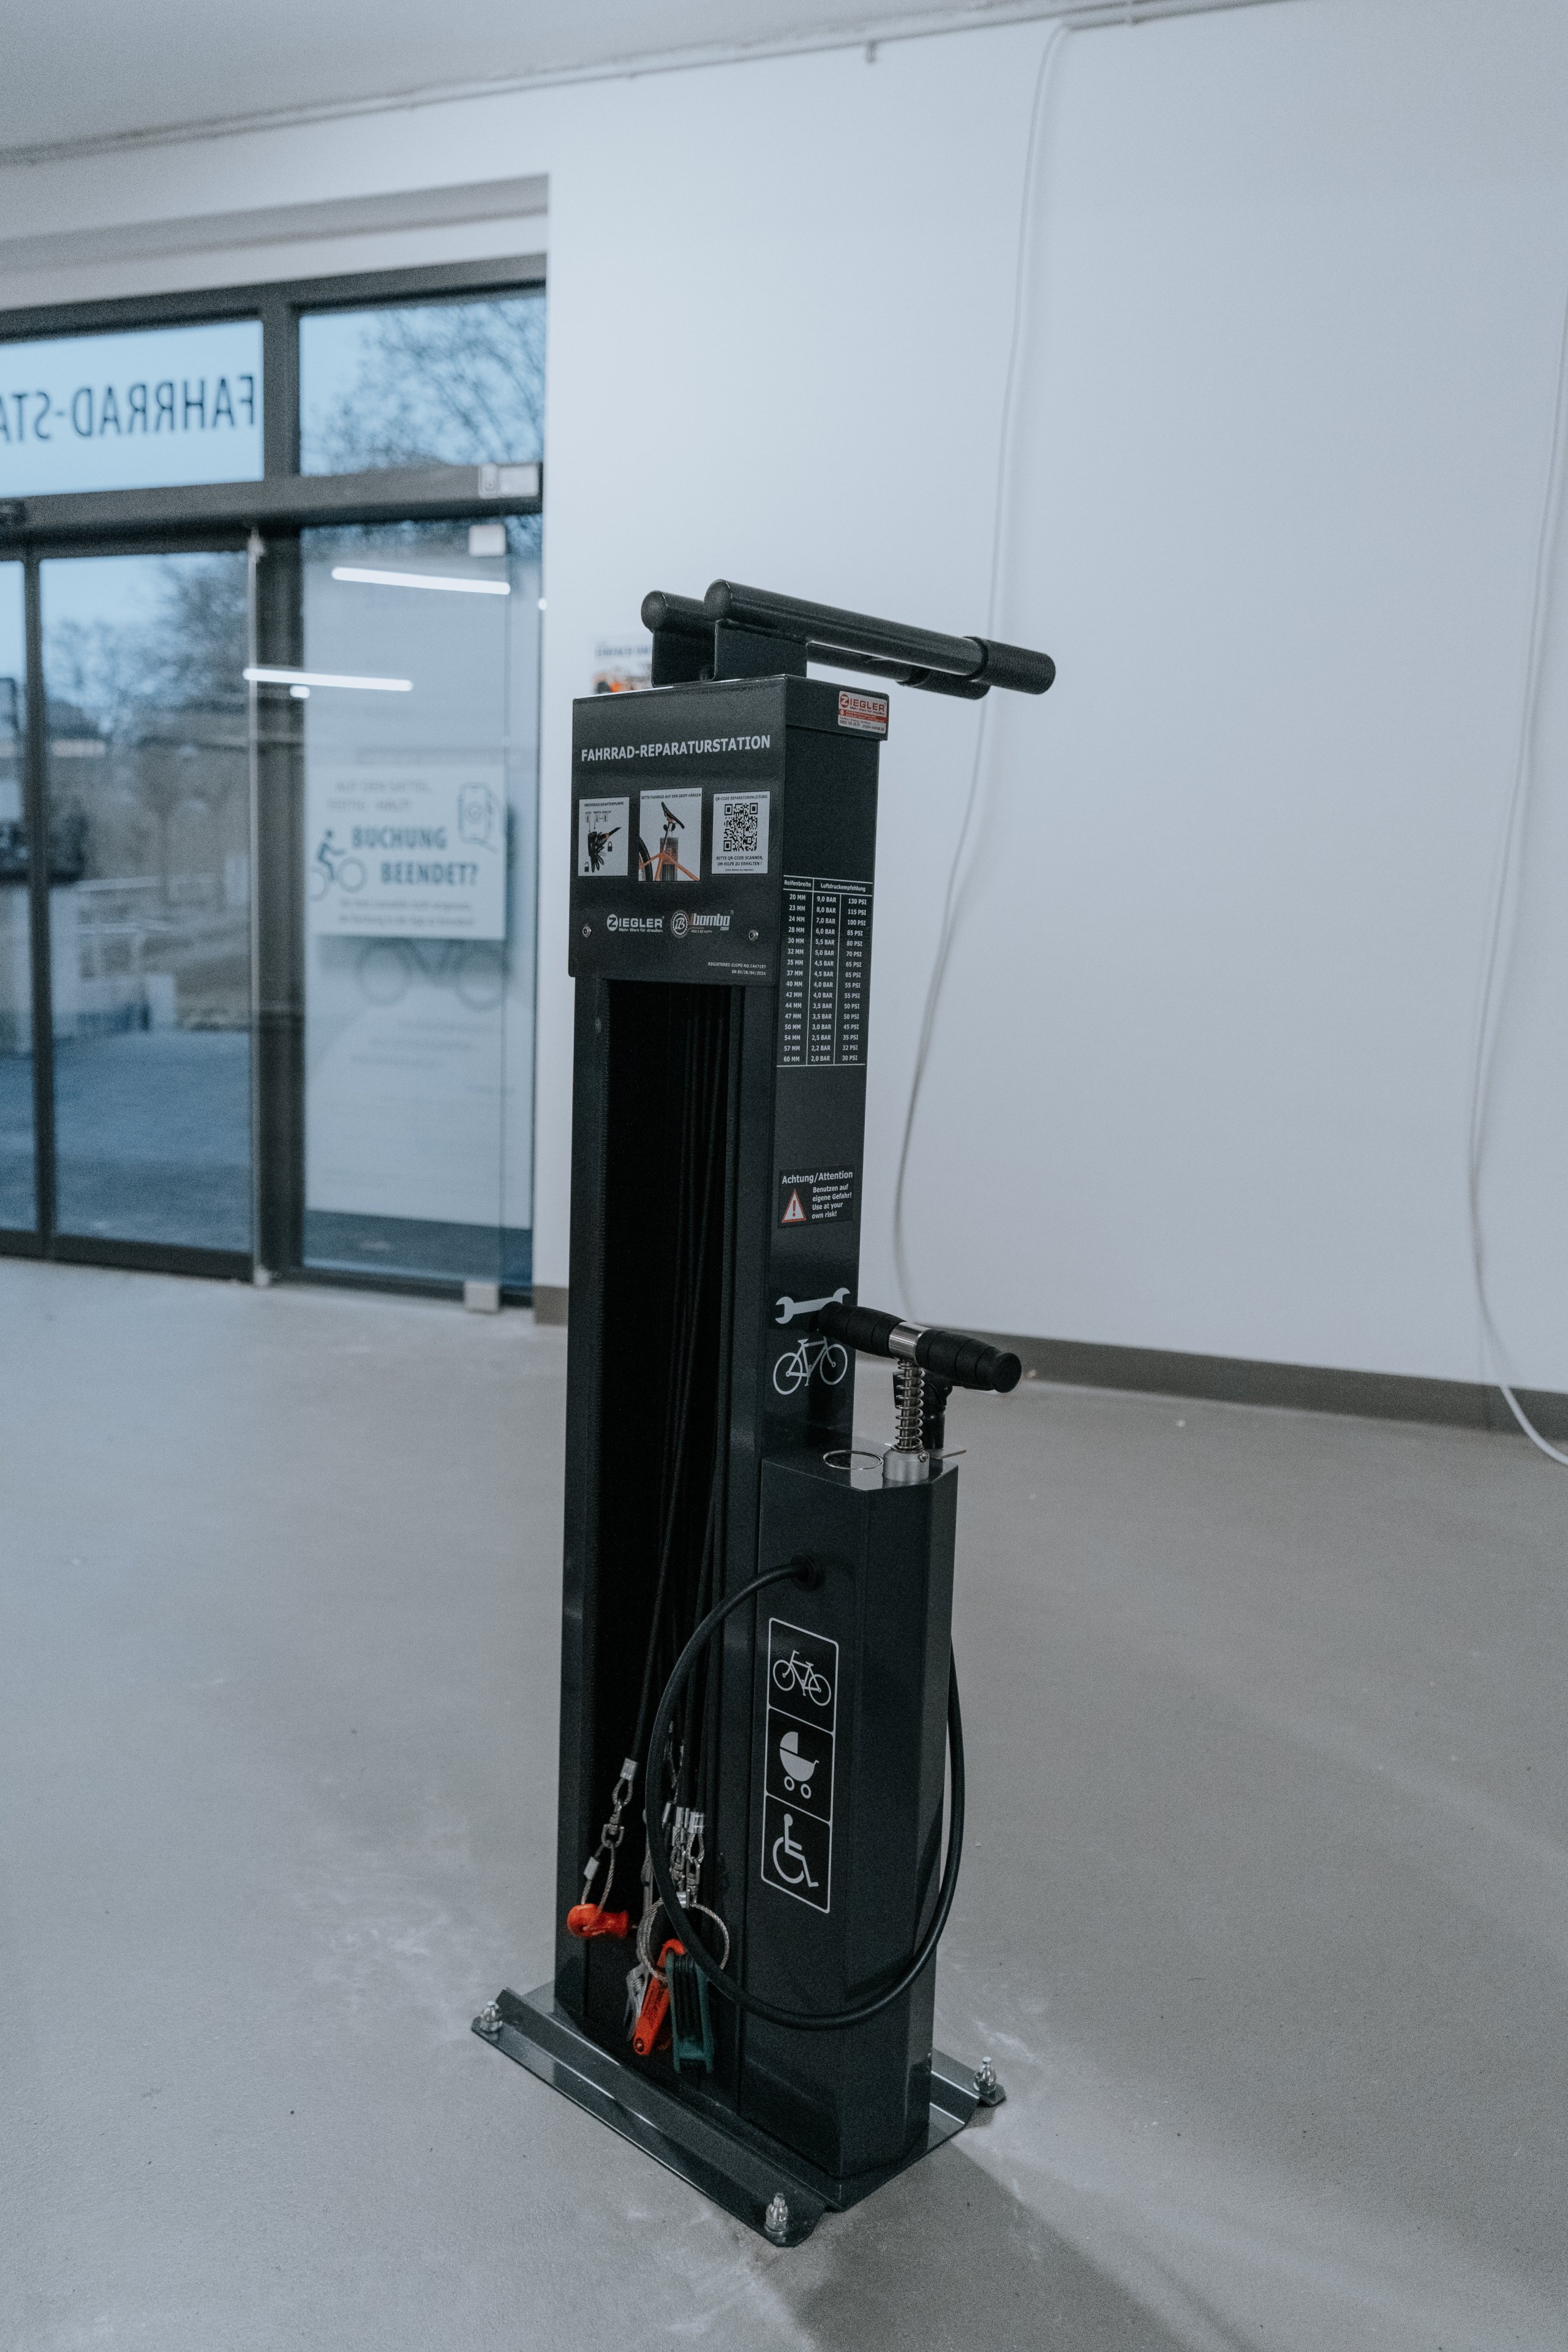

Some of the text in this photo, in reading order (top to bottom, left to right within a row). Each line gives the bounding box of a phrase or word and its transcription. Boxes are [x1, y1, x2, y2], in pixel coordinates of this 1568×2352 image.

[840, 694, 885, 712] ZIEGLER
[581, 735, 771, 762] FAHRRAD-REPARATURSTATION
[351, 826, 448, 850] BUCHUNG
[380, 861, 478, 885] BEENDET?
[821, 883, 865, 892] Luftdruckempfehlung
[607, 914, 662, 931] ZIEGLER
[782, 1170, 853, 1184] Achtung/Attention
